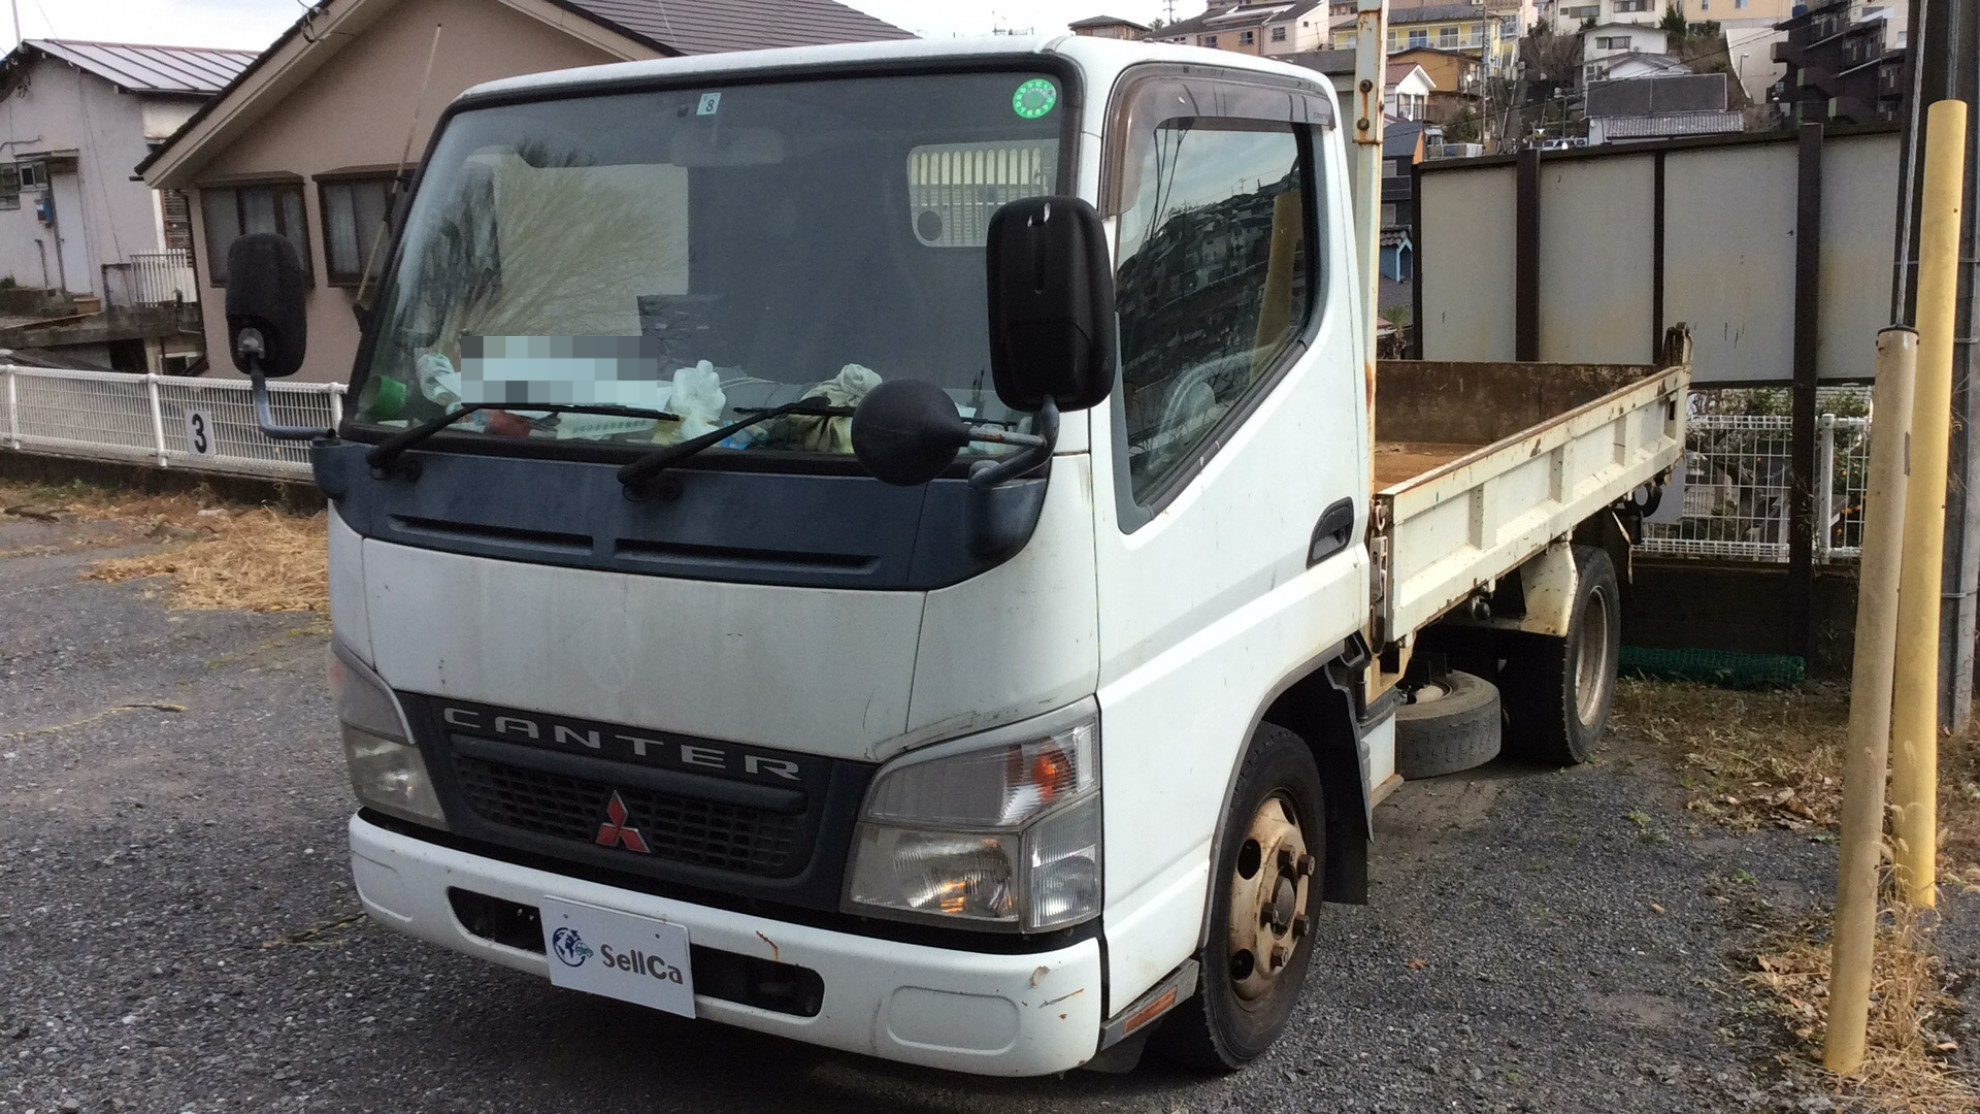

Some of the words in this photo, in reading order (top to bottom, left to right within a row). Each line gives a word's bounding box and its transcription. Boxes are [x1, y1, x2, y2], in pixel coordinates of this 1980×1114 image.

[706, 99, 715, 112] 8
[192, 413, 207, 454] 3
[444, 707, 801, 781] CANTER
[600, 944, 684, 985] SellCa
